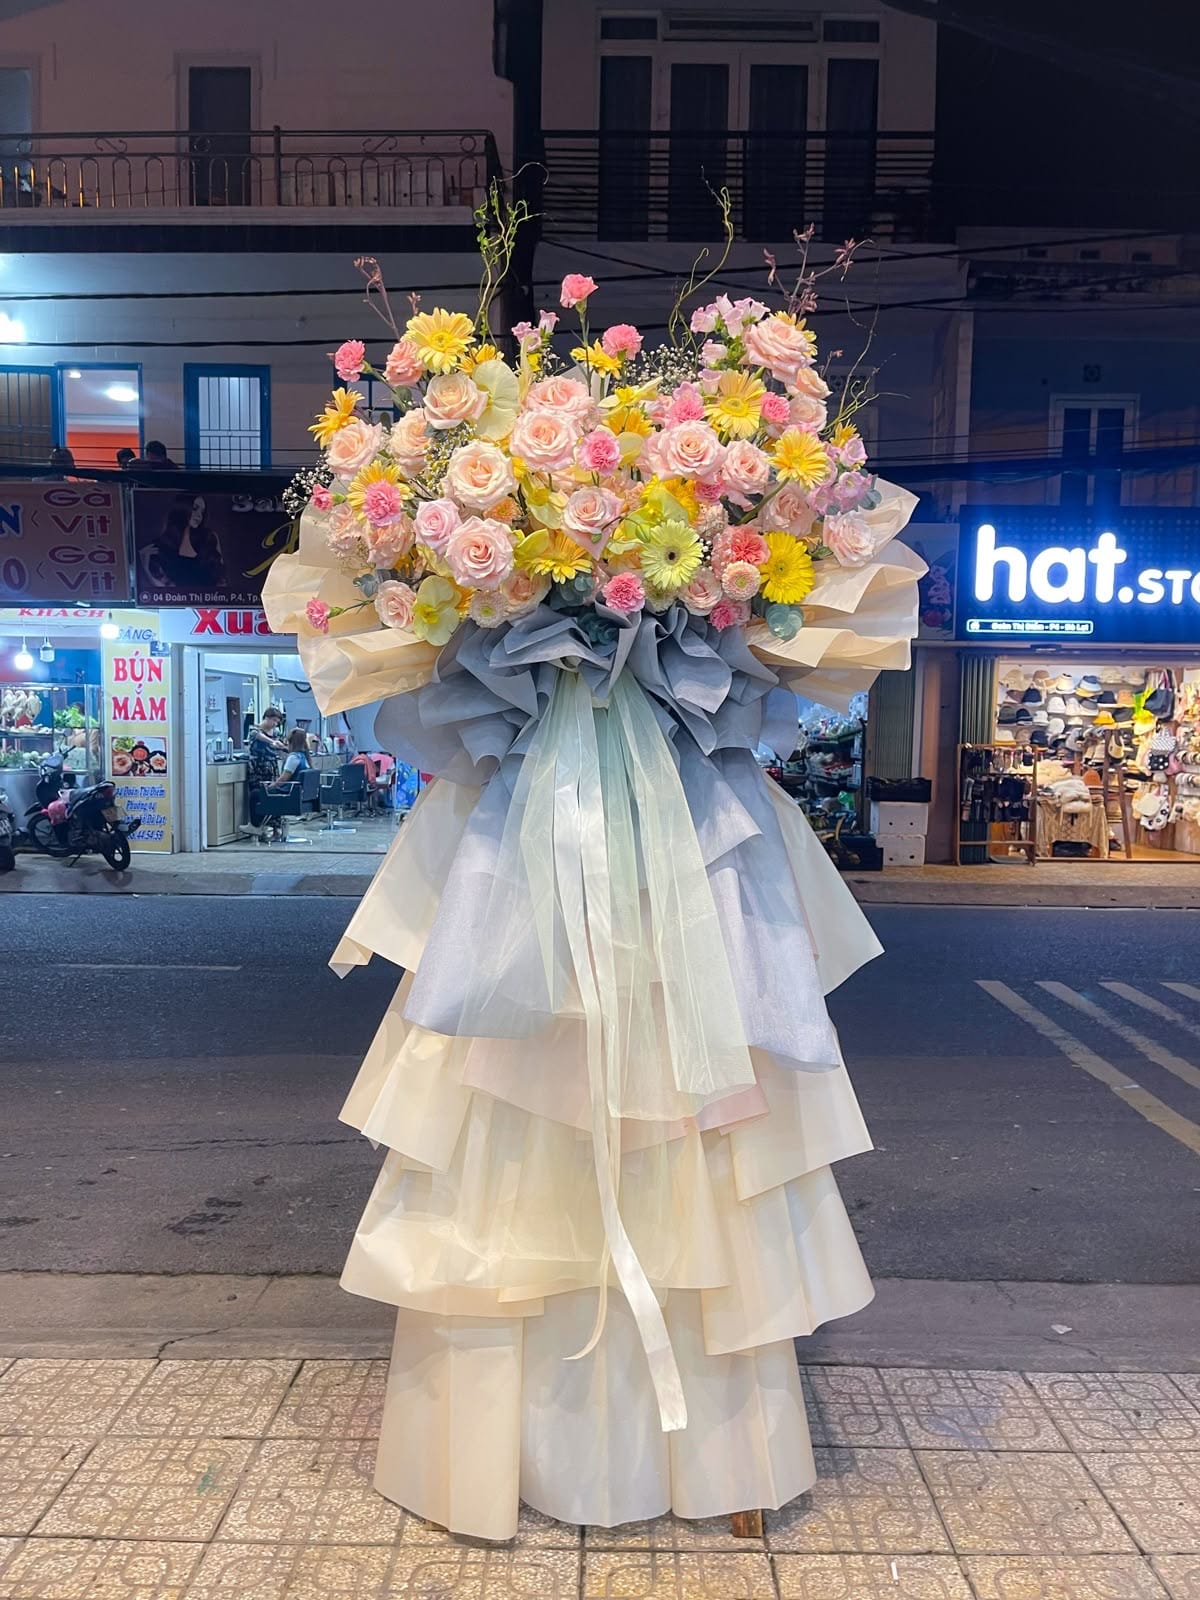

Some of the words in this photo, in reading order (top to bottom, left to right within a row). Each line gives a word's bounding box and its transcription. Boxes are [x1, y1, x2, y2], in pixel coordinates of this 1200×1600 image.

[43, 487, 112, 508] Gà
[51, 514, 111, 538] Vịt
[48, 544, 116, 565] Gà
[974, 524, 1200, 605] hat.ST
[55, 571, 115, 595] Vịt
[153, 593, 163, 601] 04
[165, 592, 187, 601] Đoàn
[188, 593, 203, 603] Thị
[113, 650, 163, 683] BÚN
[111, 683, 167, 721] MẮM
